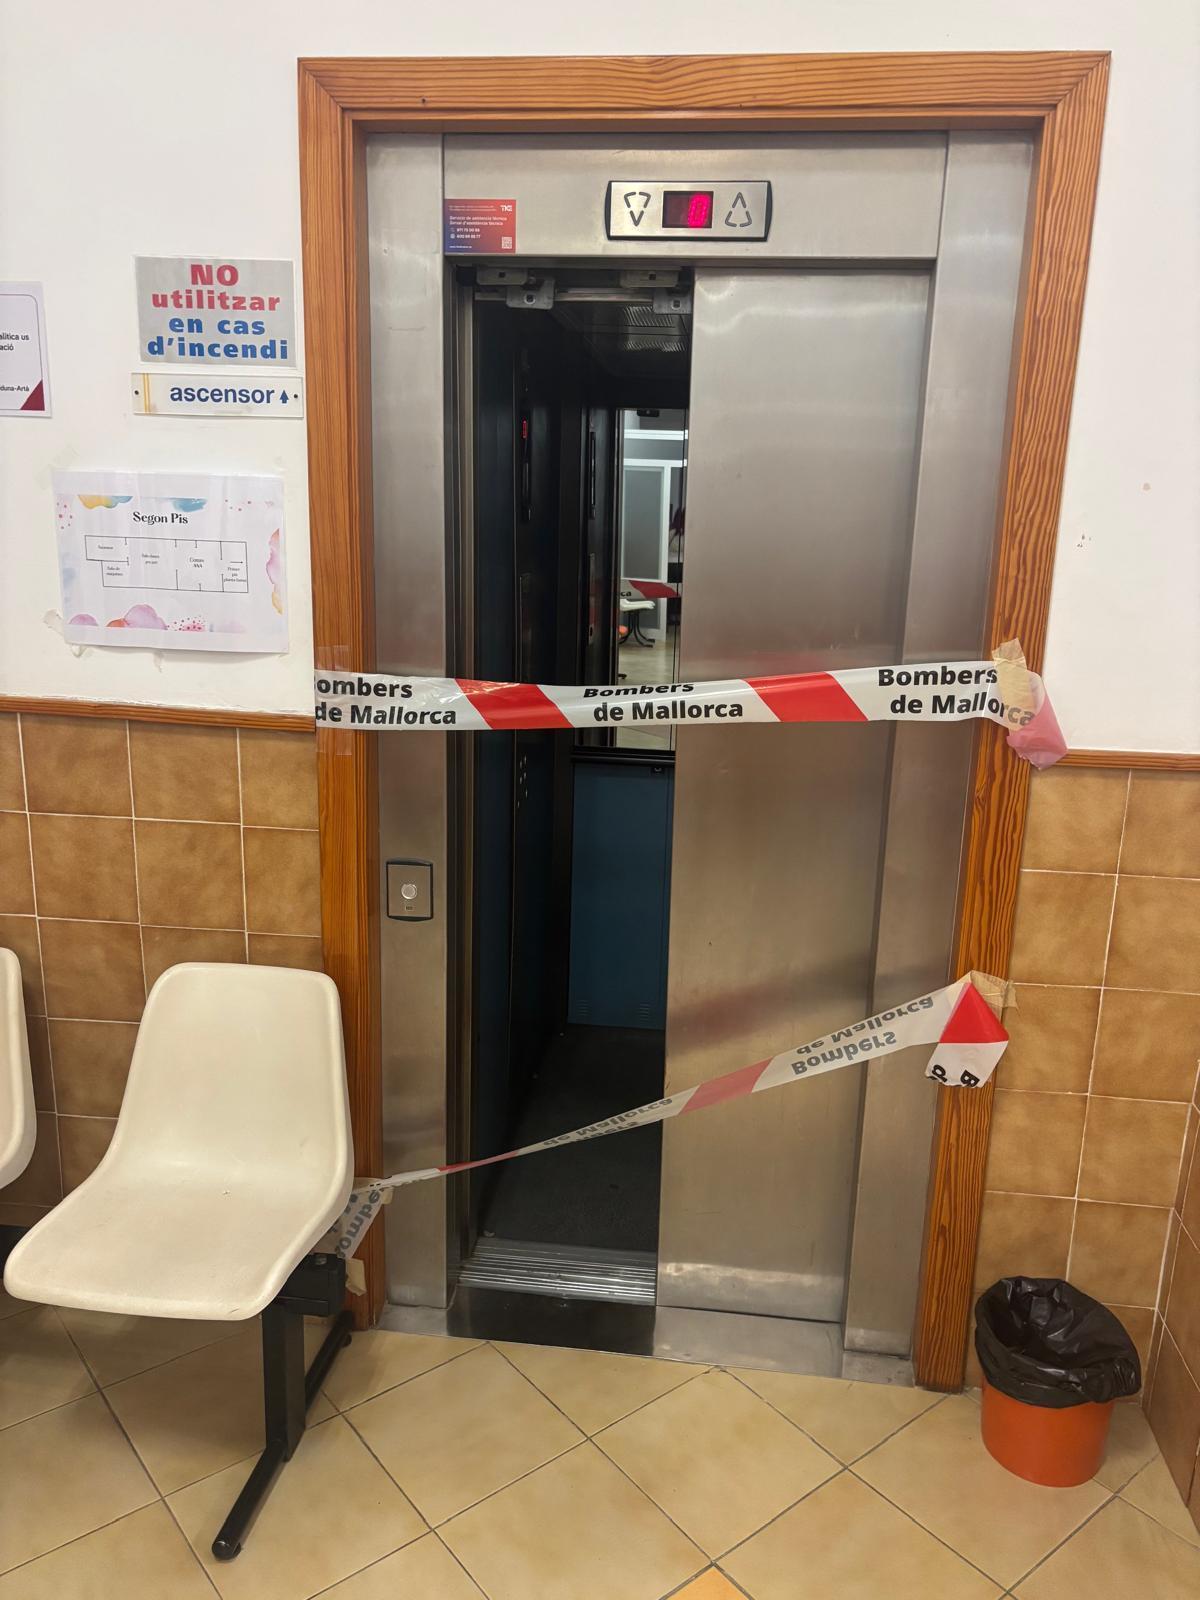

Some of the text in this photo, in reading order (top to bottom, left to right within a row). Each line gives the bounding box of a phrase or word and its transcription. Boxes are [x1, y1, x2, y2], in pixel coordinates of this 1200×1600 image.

[190, 264, 239, 286] NO
[152, 289, 280, 311] utilitzar
[169, 317, 266, 335] en cas
[147, 336, 288, 359] d'incendi
[170, 386, 275, 404] ascensor
[133, 511, 188, 525] Segon Pis
[877, 666, 998, 687] Bombers
[314, 677, 413, 698] ombers
[583, 683, 694, 698] Bombers
[315, 702, 456, 725] de Mallorca
[593, 700, 743, 722] de Mallorca
[890, 692, 1035, 726] de Mallorca
